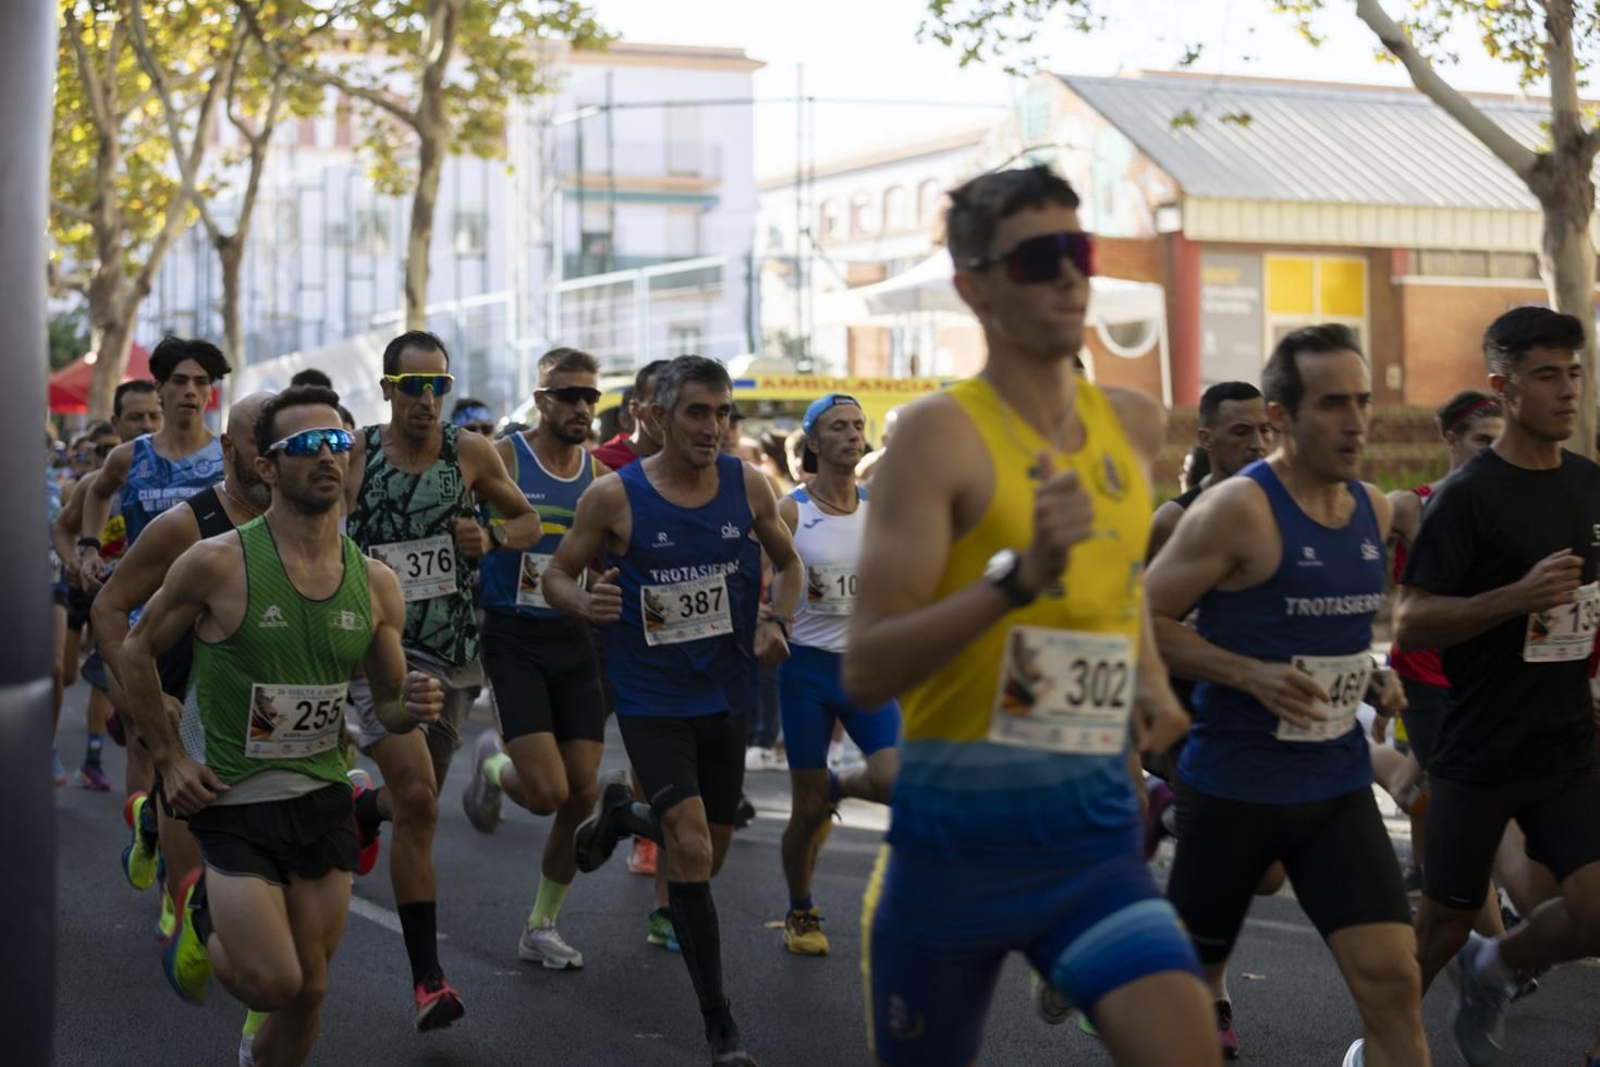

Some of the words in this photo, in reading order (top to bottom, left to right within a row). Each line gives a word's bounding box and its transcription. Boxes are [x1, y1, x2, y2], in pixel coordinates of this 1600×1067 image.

[762, 377, 937, 392] AMBULANCIA
[406, 548, 452, 578] 376
[679, 586, 723, 618] 387
[1066, 659, 1126, 707] 302
[293, 697, 343, 730] 255
